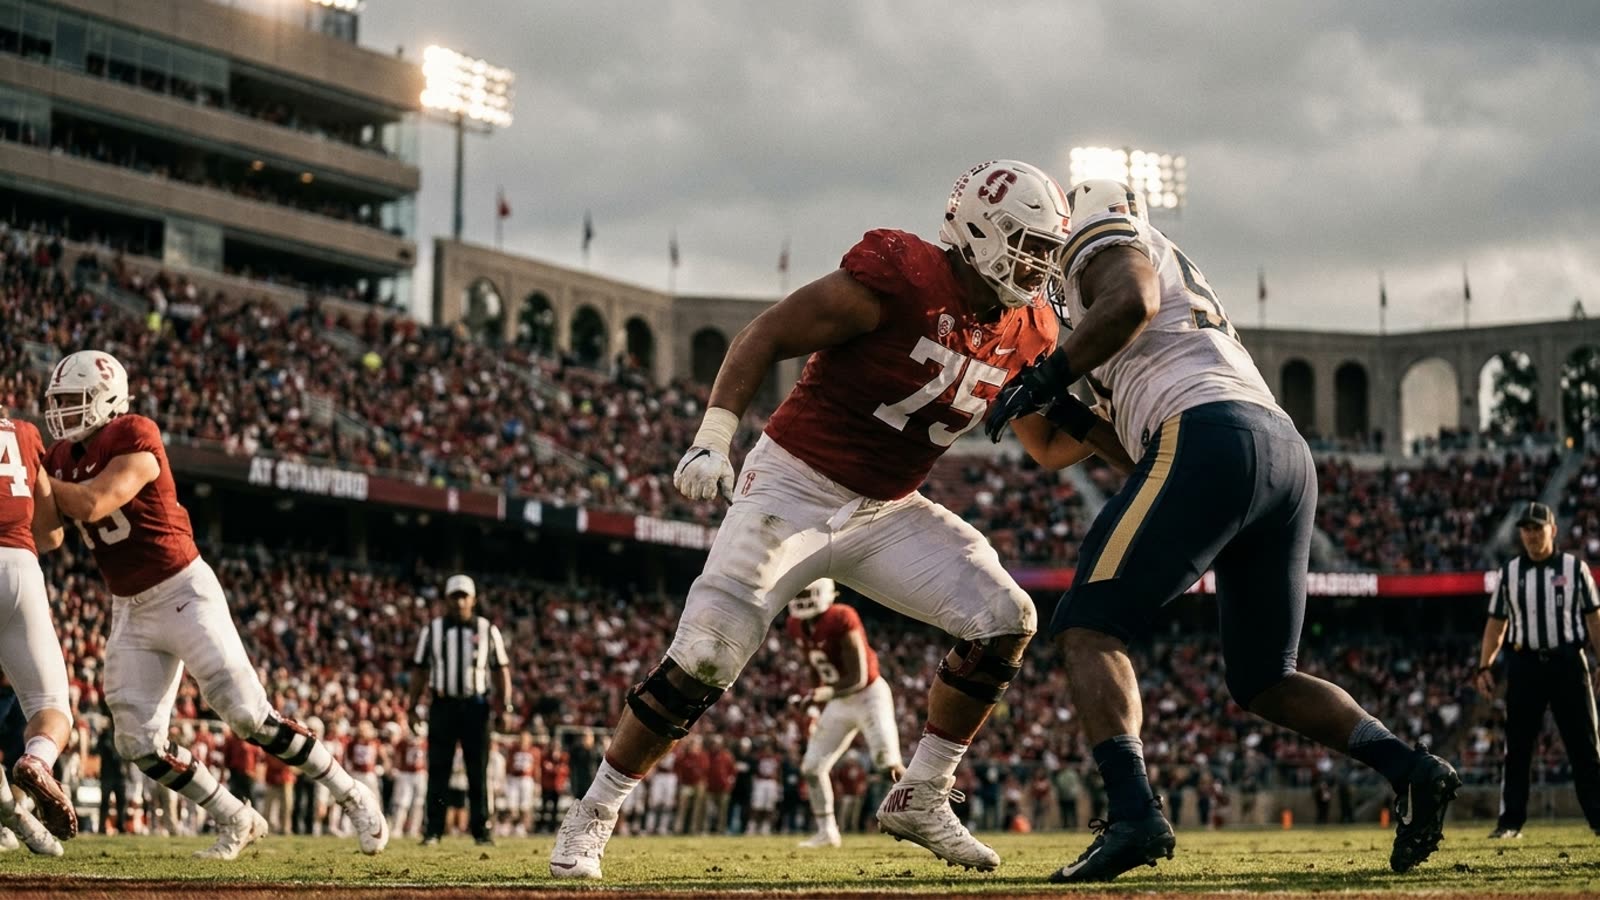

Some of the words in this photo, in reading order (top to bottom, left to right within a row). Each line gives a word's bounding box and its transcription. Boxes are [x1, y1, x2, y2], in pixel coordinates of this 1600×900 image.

[978, 169, 1017, 204] S
[872, 335, 1010, 448] 75
[808, 649, 841, 684] 6
